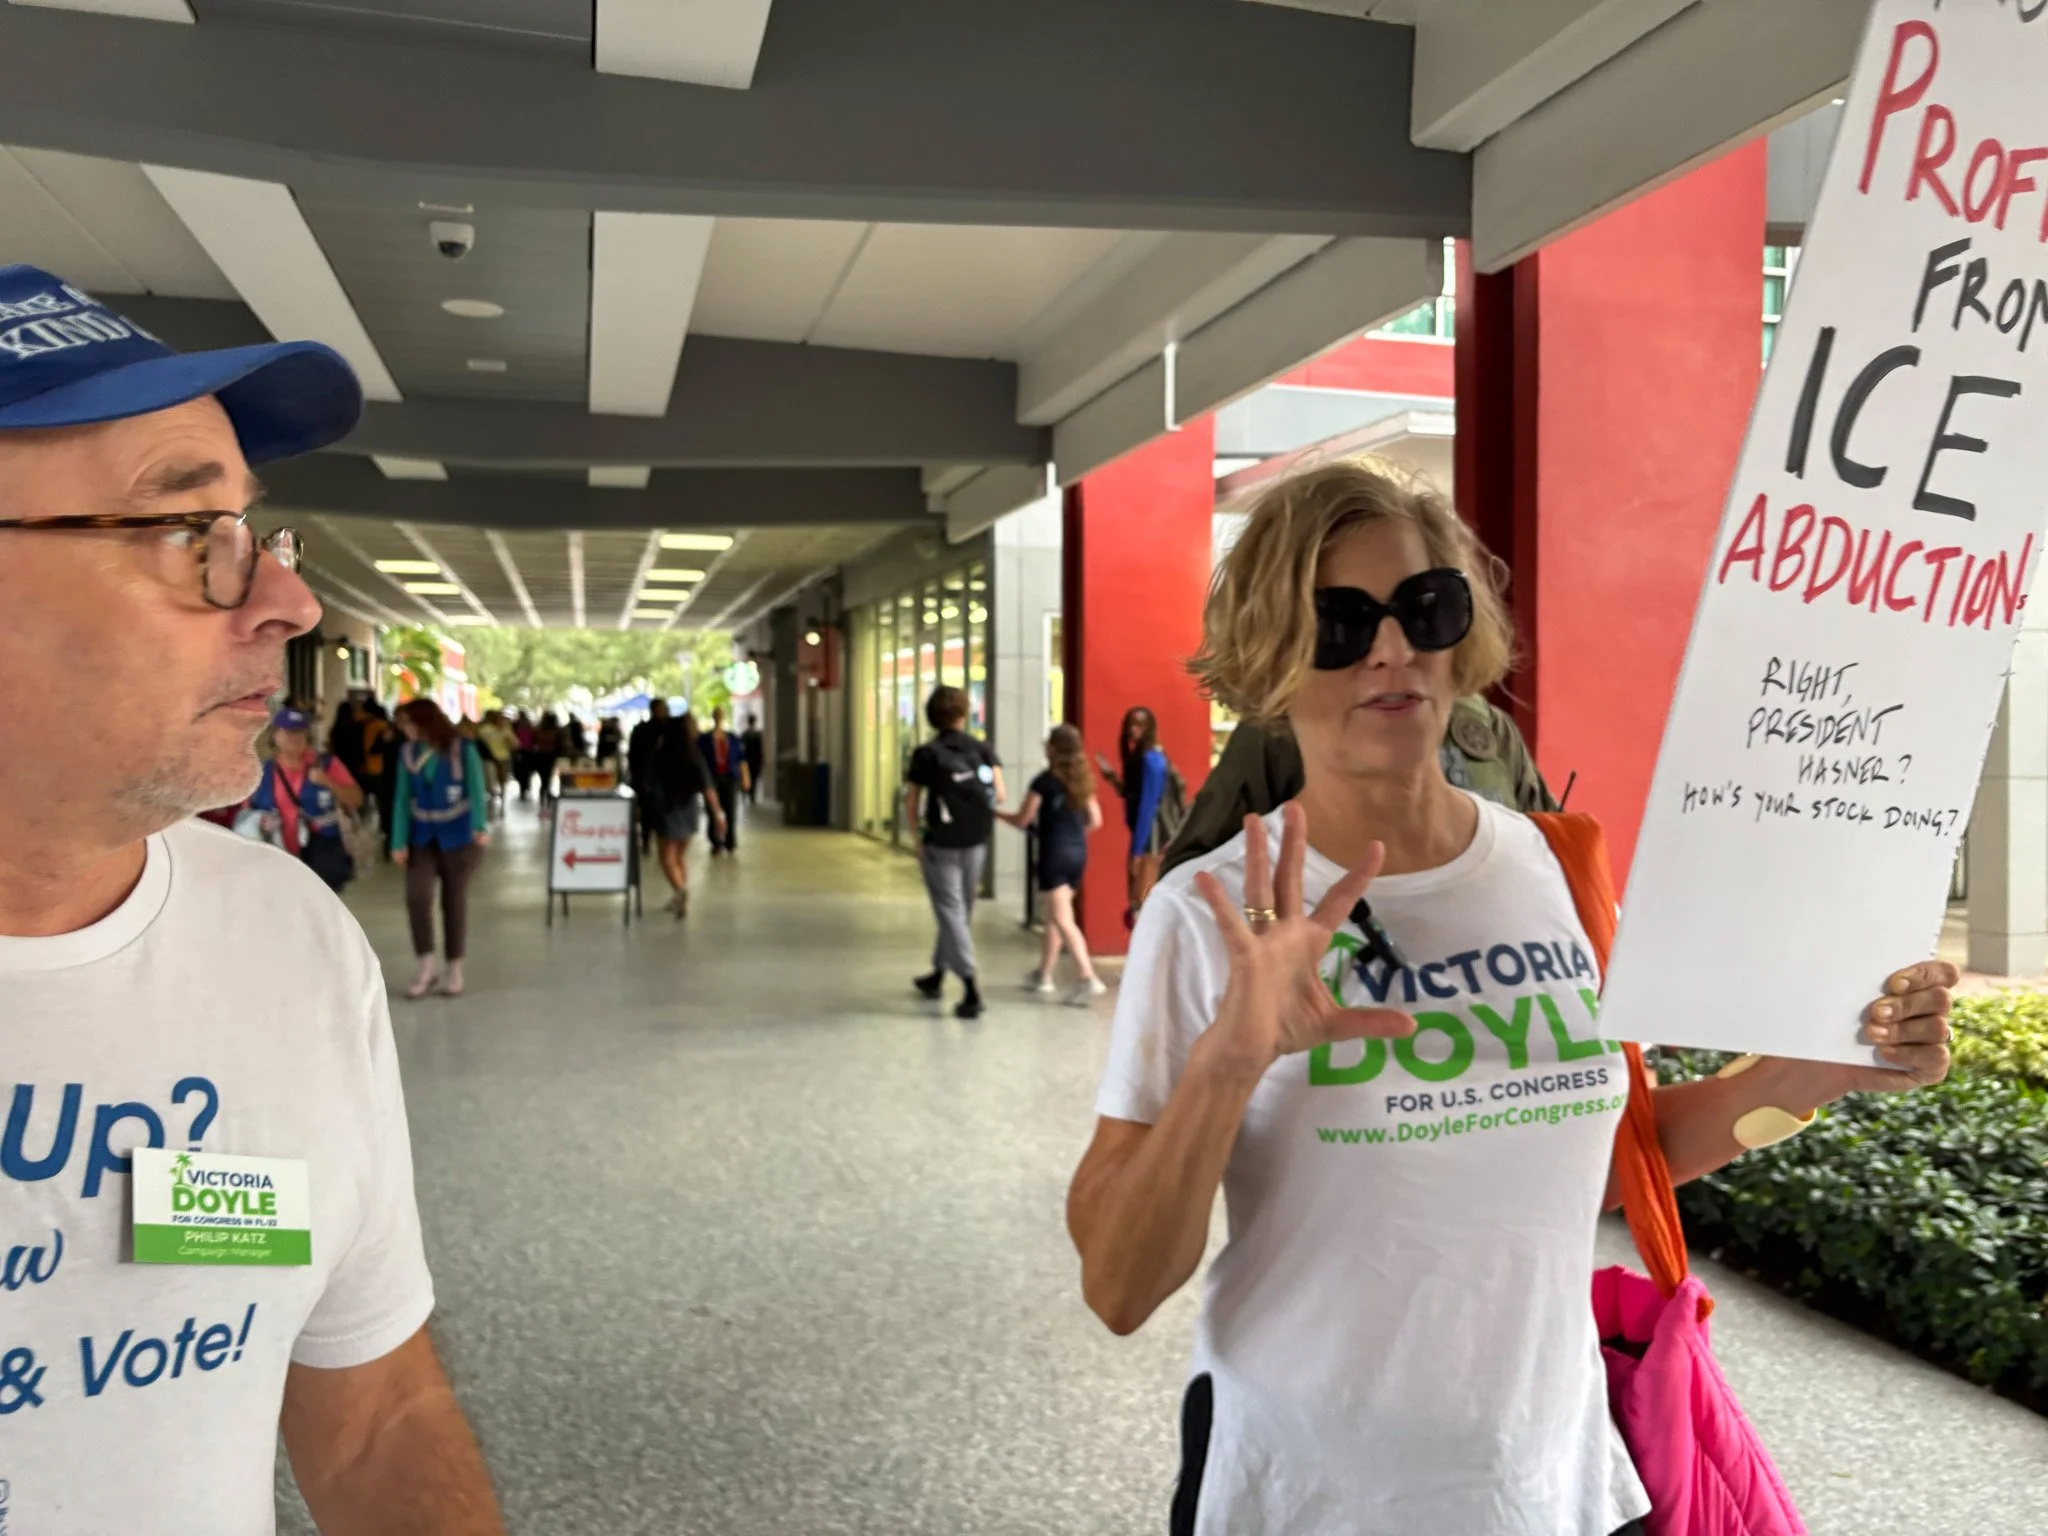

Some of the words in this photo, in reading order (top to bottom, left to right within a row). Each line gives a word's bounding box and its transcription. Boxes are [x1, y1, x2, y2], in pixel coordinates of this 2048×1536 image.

[1858, 20, 2048, 243] PROF
[1786, 326, 2021, 521] ICE
[1762, 657, 1858, 706] RIGHT,
[1747, 704, 1903, 748] PRESIDENT
[1755, 793, 1800, 822] YOUR
[1812, 797, 1873, 824] STOCK
[1884, 806, 1959, 836] DOING?
[1353, 941, 1595, 1002] VICTORIA
[1386, 1094, 1433, 1114] FOR
[1441, 1088, 1482, 1108] U.S.
[1490, 1068, 1609, 1100] CONGRESS
[1, 1076, 219, 1198] Up?
[172, 1185, 277, 1215] DOYLE
[187, 1169, 273, 1189] VICTORIA
[184, 1230, 228, 1243] PHILIP
[231, 1232, 266, 1244] KATZ
[0, 1347, 48, 1415] &
[79, 1303, 257, 1397] Vote!
